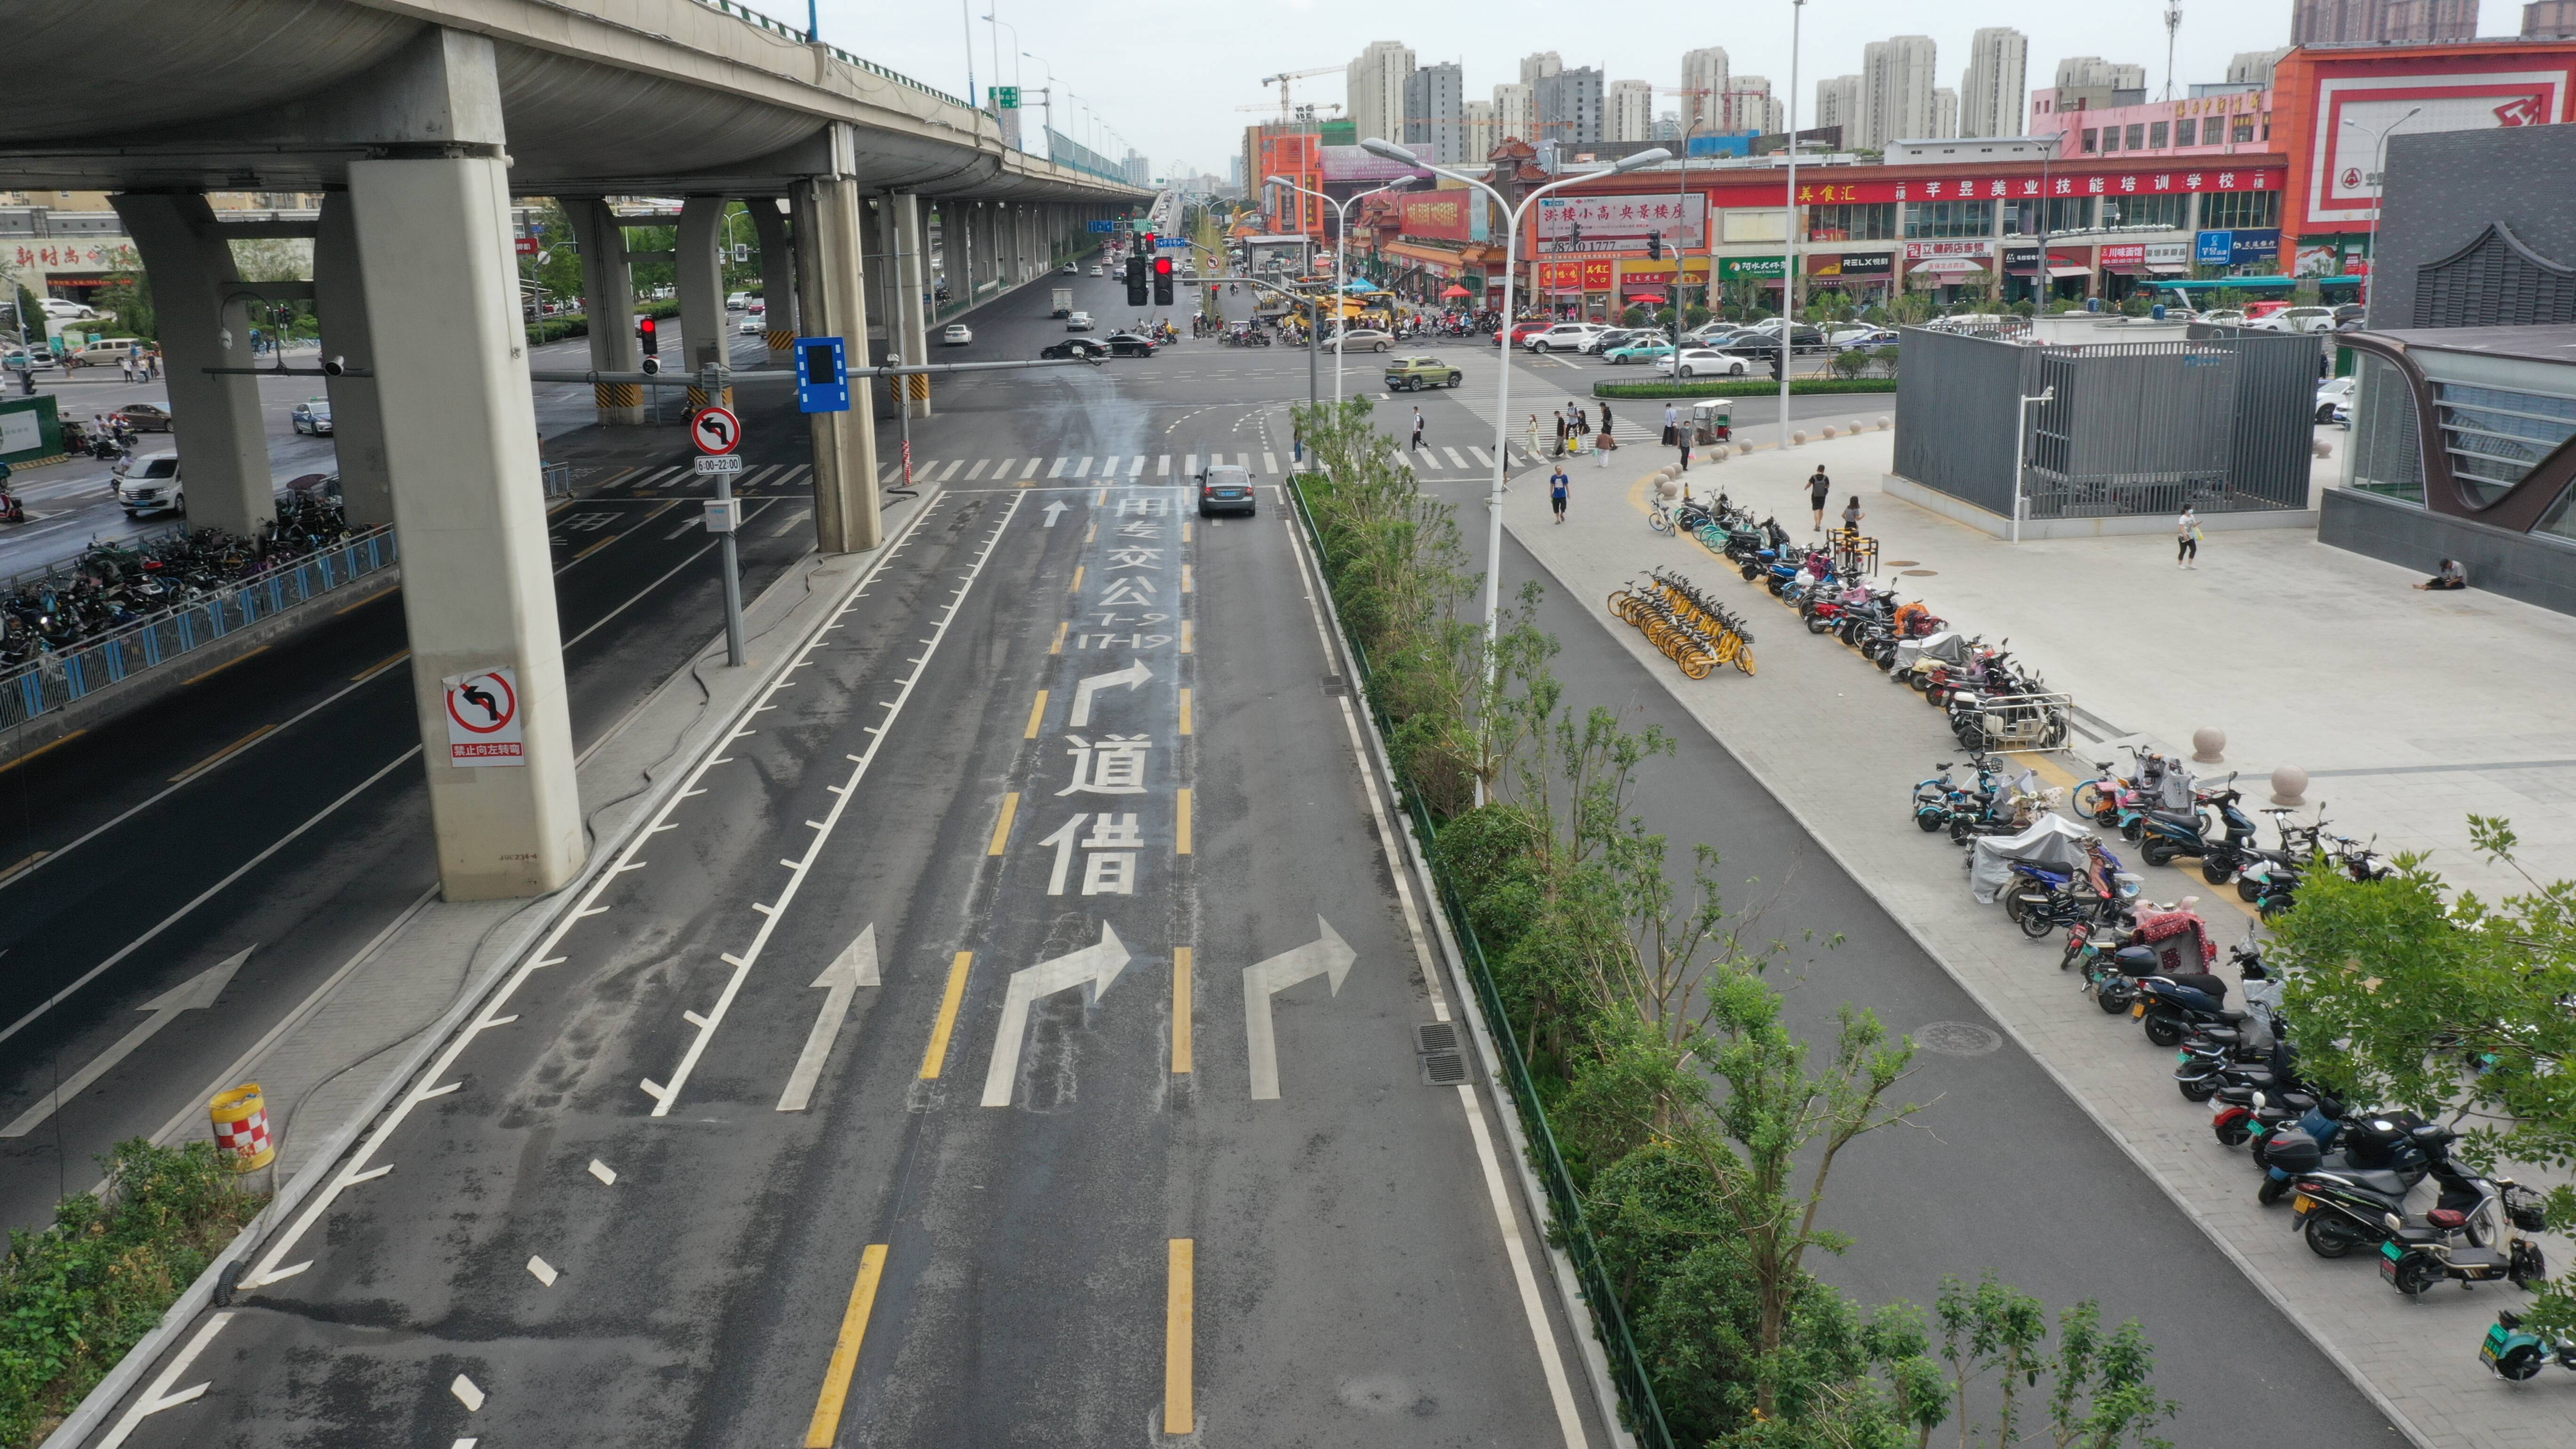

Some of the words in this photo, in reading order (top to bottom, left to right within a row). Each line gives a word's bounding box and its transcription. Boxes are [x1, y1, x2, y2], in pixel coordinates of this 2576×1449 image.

[2253, 169, 2264, 189] 二楼
[1798, 184, 1856, 202] 美食汇
[1895, 182, 1907, 201] 二楼
[1922, 242, 1984, 255] 立健药店连锁
[2108, 247, 2143, 258] 川味面馆
[16, 245, 81, 269] 新时尚
[1586, 265, 1610, 275] 美食汇
[453, 744, 520, 757] 禁止向左转弯
